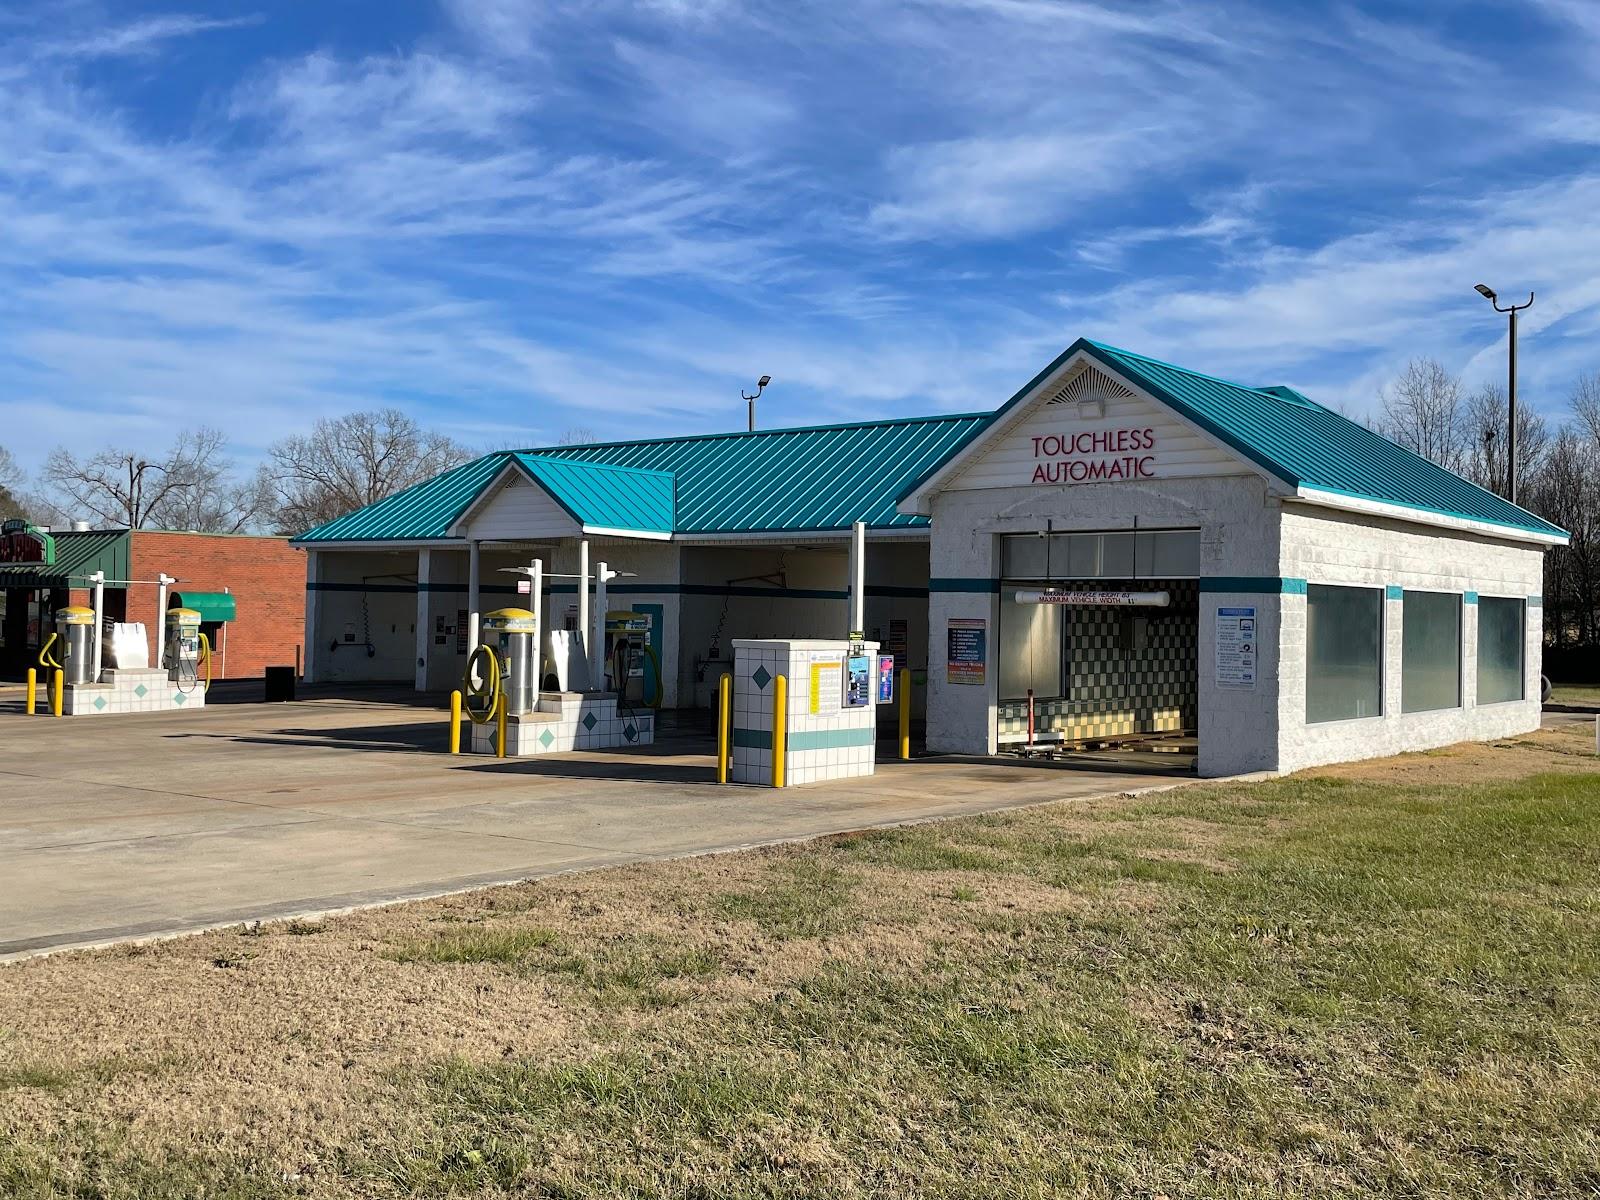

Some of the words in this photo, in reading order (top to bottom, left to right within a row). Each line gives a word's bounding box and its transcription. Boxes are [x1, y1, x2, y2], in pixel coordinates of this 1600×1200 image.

[1031, 428, 1154, 458] TOUCHLESS
[1031, 456, 1155, 484] AUTOMATIC
[1039, 596, 1070, 604] MAXIMUM
[1072, 596, 1097, 604] VEHICLE
